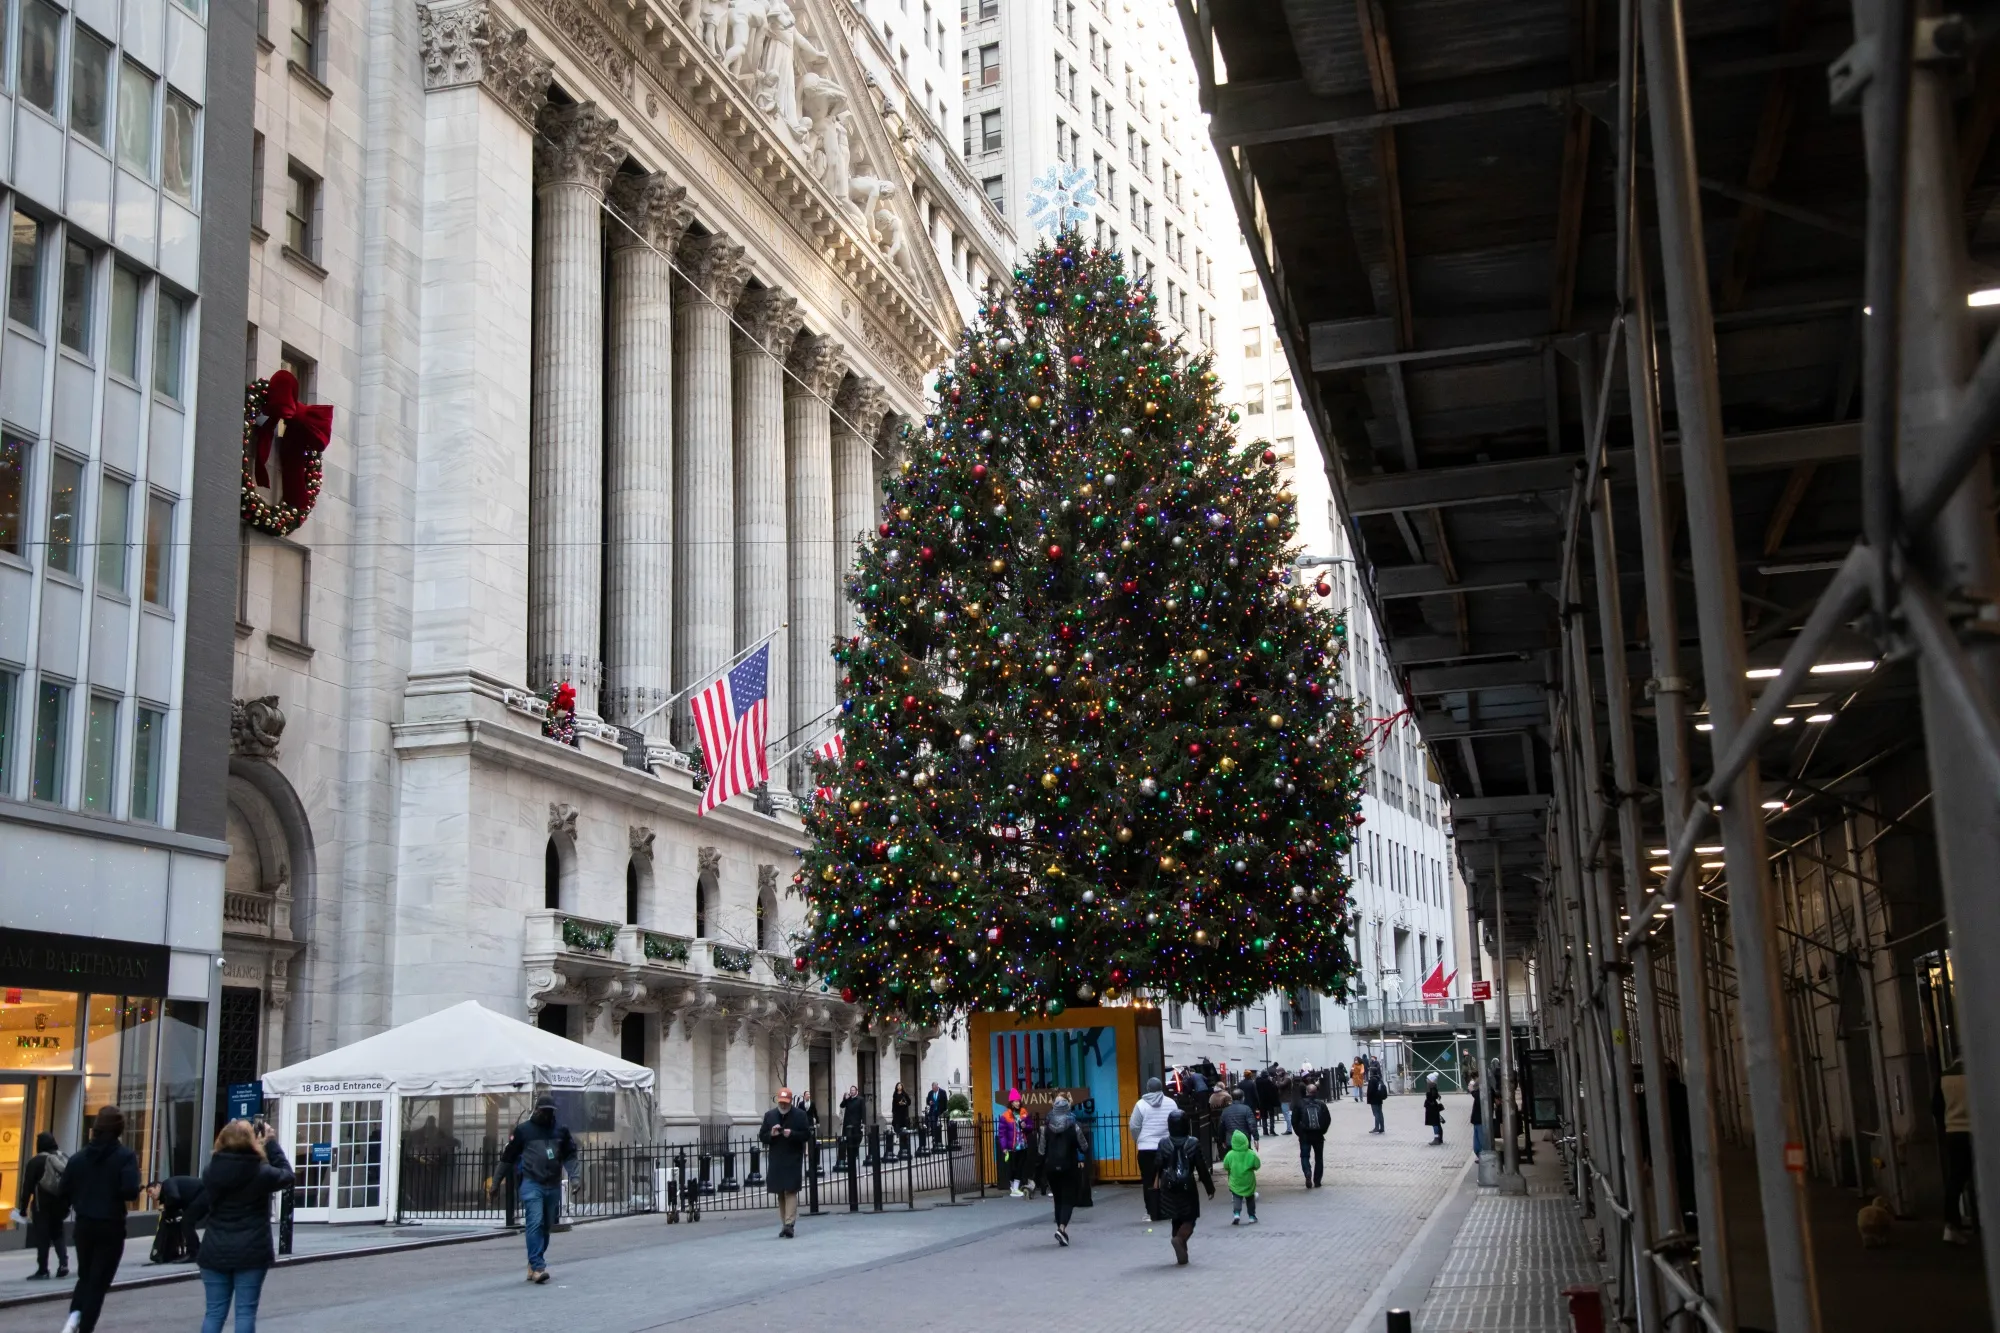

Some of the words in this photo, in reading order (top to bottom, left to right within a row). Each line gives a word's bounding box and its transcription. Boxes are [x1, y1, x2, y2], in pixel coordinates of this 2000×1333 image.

[668, 112, 695, 157] NEW
[702, 149, 736, 204] YORK
[742, 194, 777, 247] STOCK
[45, 950, 149, 979] BARTHMAN
[16, 1035, 60, 1049] ROLEX
[558, 1074, 570, 1082] Broad
[302, 1084, 312, 1093] 18
[314, 1080, 340, 1092] Broad
[343, 1080, 382, 1091] Entrance
